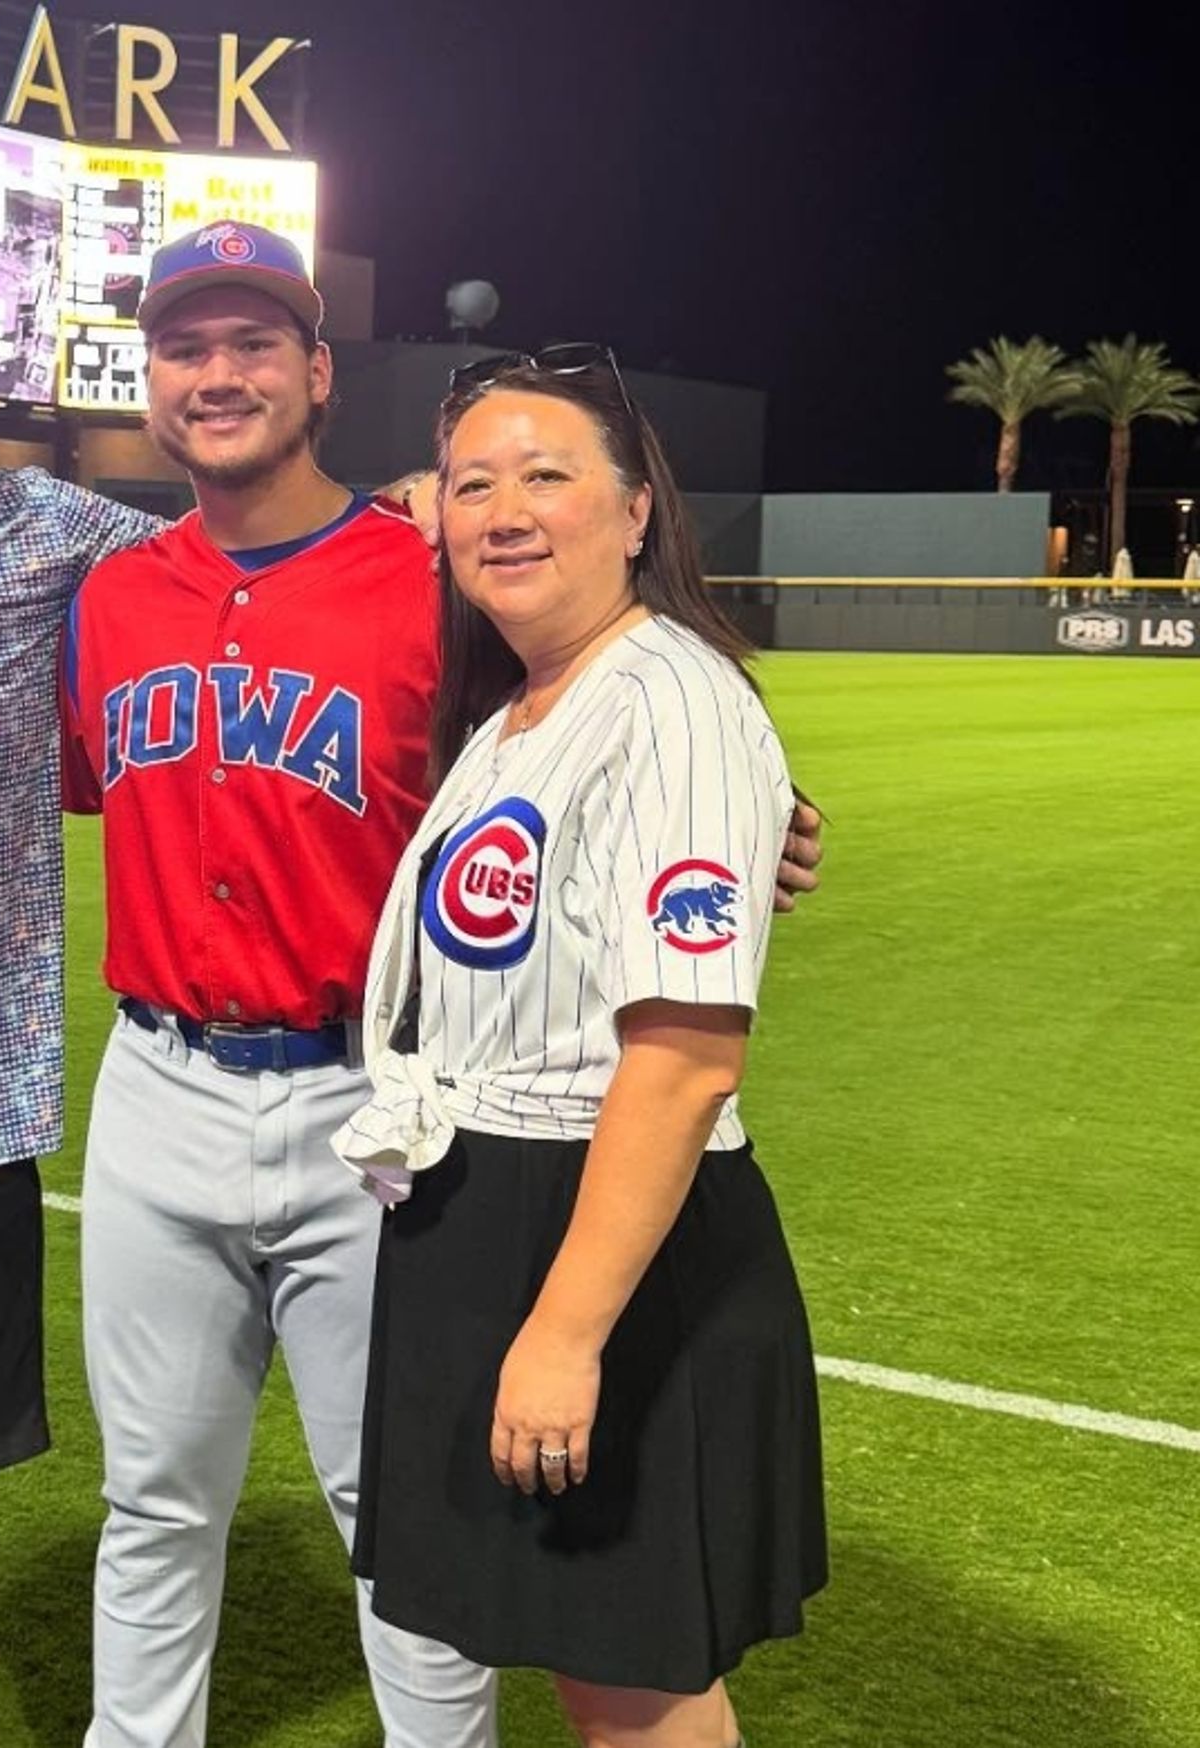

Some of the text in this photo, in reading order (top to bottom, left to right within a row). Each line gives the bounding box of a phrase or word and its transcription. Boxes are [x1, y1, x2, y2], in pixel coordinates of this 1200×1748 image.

[1140, 619, 1194, 647] LAS
[102, 662, 367, 817] IOWA
[443, 824, 534, 940] CUBS
